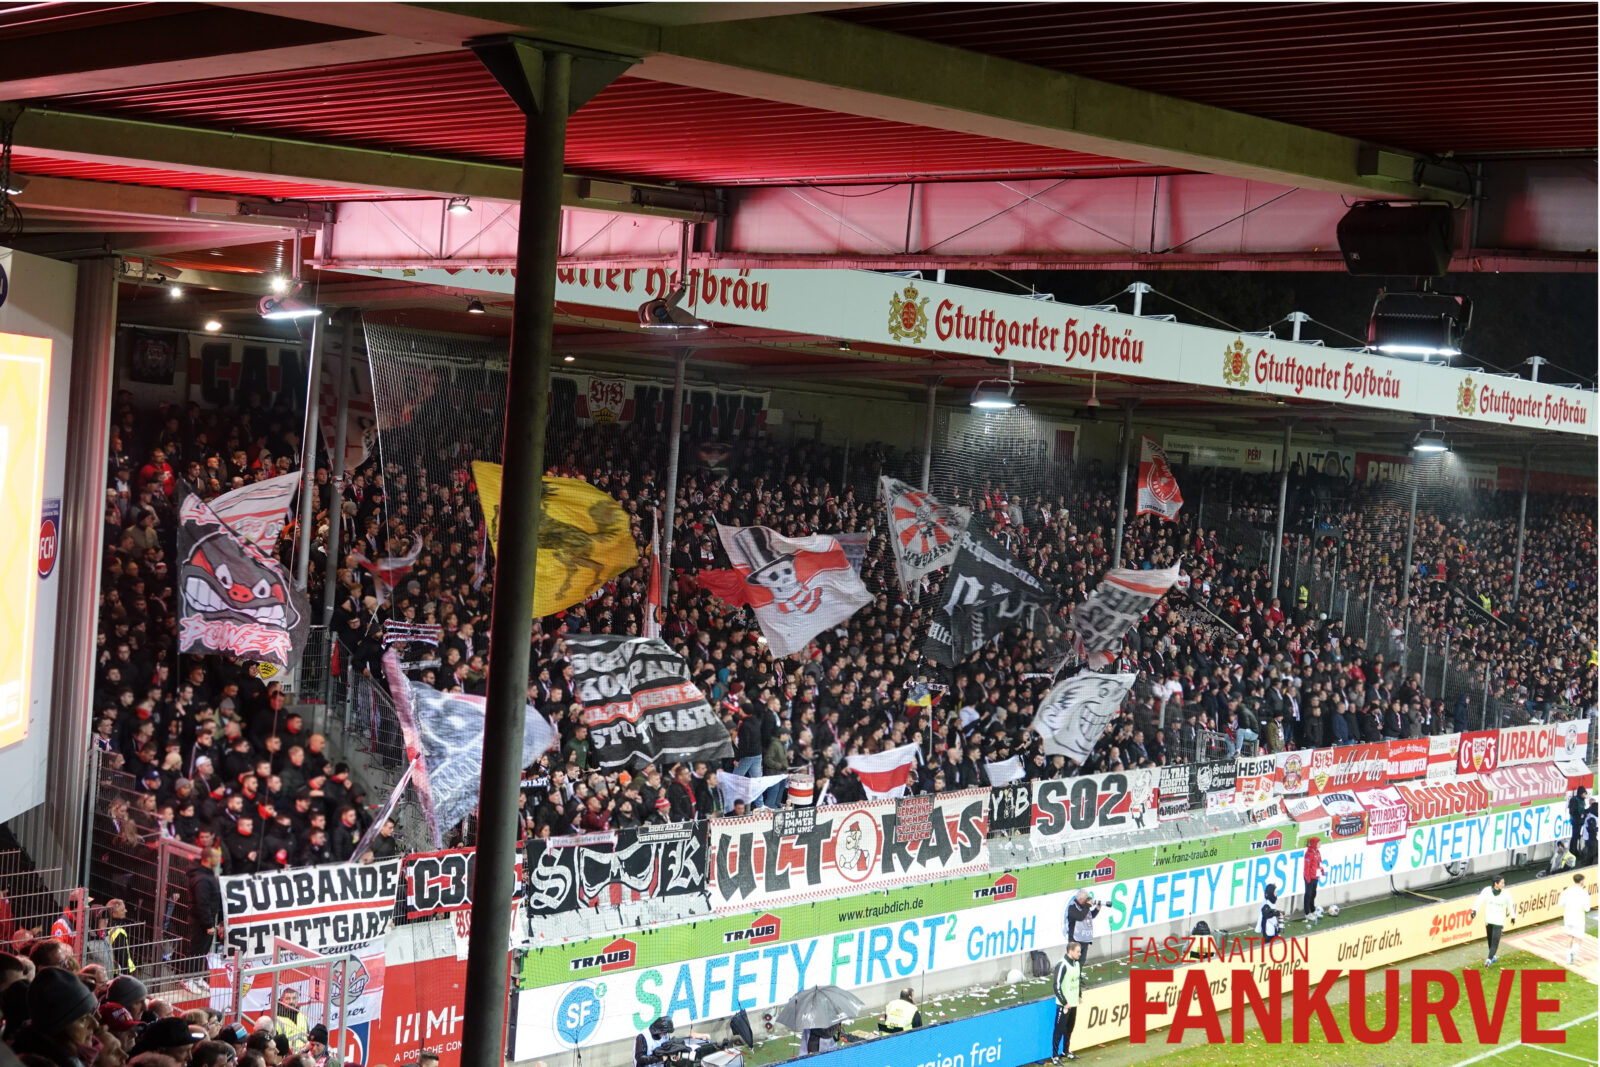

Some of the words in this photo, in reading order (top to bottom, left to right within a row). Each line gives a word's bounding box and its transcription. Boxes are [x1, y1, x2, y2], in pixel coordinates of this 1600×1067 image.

[935, 299, 1059, 355] Stuttgarter
[1063, 318, 1145, 364] Hofbräu
[1255, 349, 1341, 394] Stuttgarter
[1343, 362, 1401, 400] Hofbräu
[1479, 386, 1544, 422] Stuttgarter
[1545, 399, 1587, 425] Hofbräu
[180, 614, 293, 667] POWER
[1500, 728, 1554, 762] URBACH
[1238, 759, 1275, 776] HESSEN
[1251, 839, 1280, 850] TRAUB
[1384, 846, 1397, 860] SF
[1411, 817, 1490, 868] SAFETY
[1076, 867, 1113, 880] TRAUB
[226, 862, 400, 914] SÜDBANDE
[973, 886, 1017, 898] TRAUB
[1109, 865, 1223, 931] SAFETY
[1319, 852, 1364, 888] GmbH
[838, 898, 924, 922] www.traubdich.de
[1518, 890, 1547, 914] spielst
[227, 909, 393, 955] STUTTGART
[1443, 909, 1475, 932] LOTTO
[724, 927, 776, 942] TRAUB
[1337, 940, 1358, 962] Und
[1360, 937, 1378, 961] für
[1380, 927, 1403, 953] dich.
[571, 950, 630, 970] TRAUB
[633, 940, 817, 1031] SAFETY
[967, 916, 1037, 961] GmbH
[565, 1001, 591, 1029] SF
[1088, 1006, 1108, 1029] Du
[970, 1038, 1002, 1063] frei
